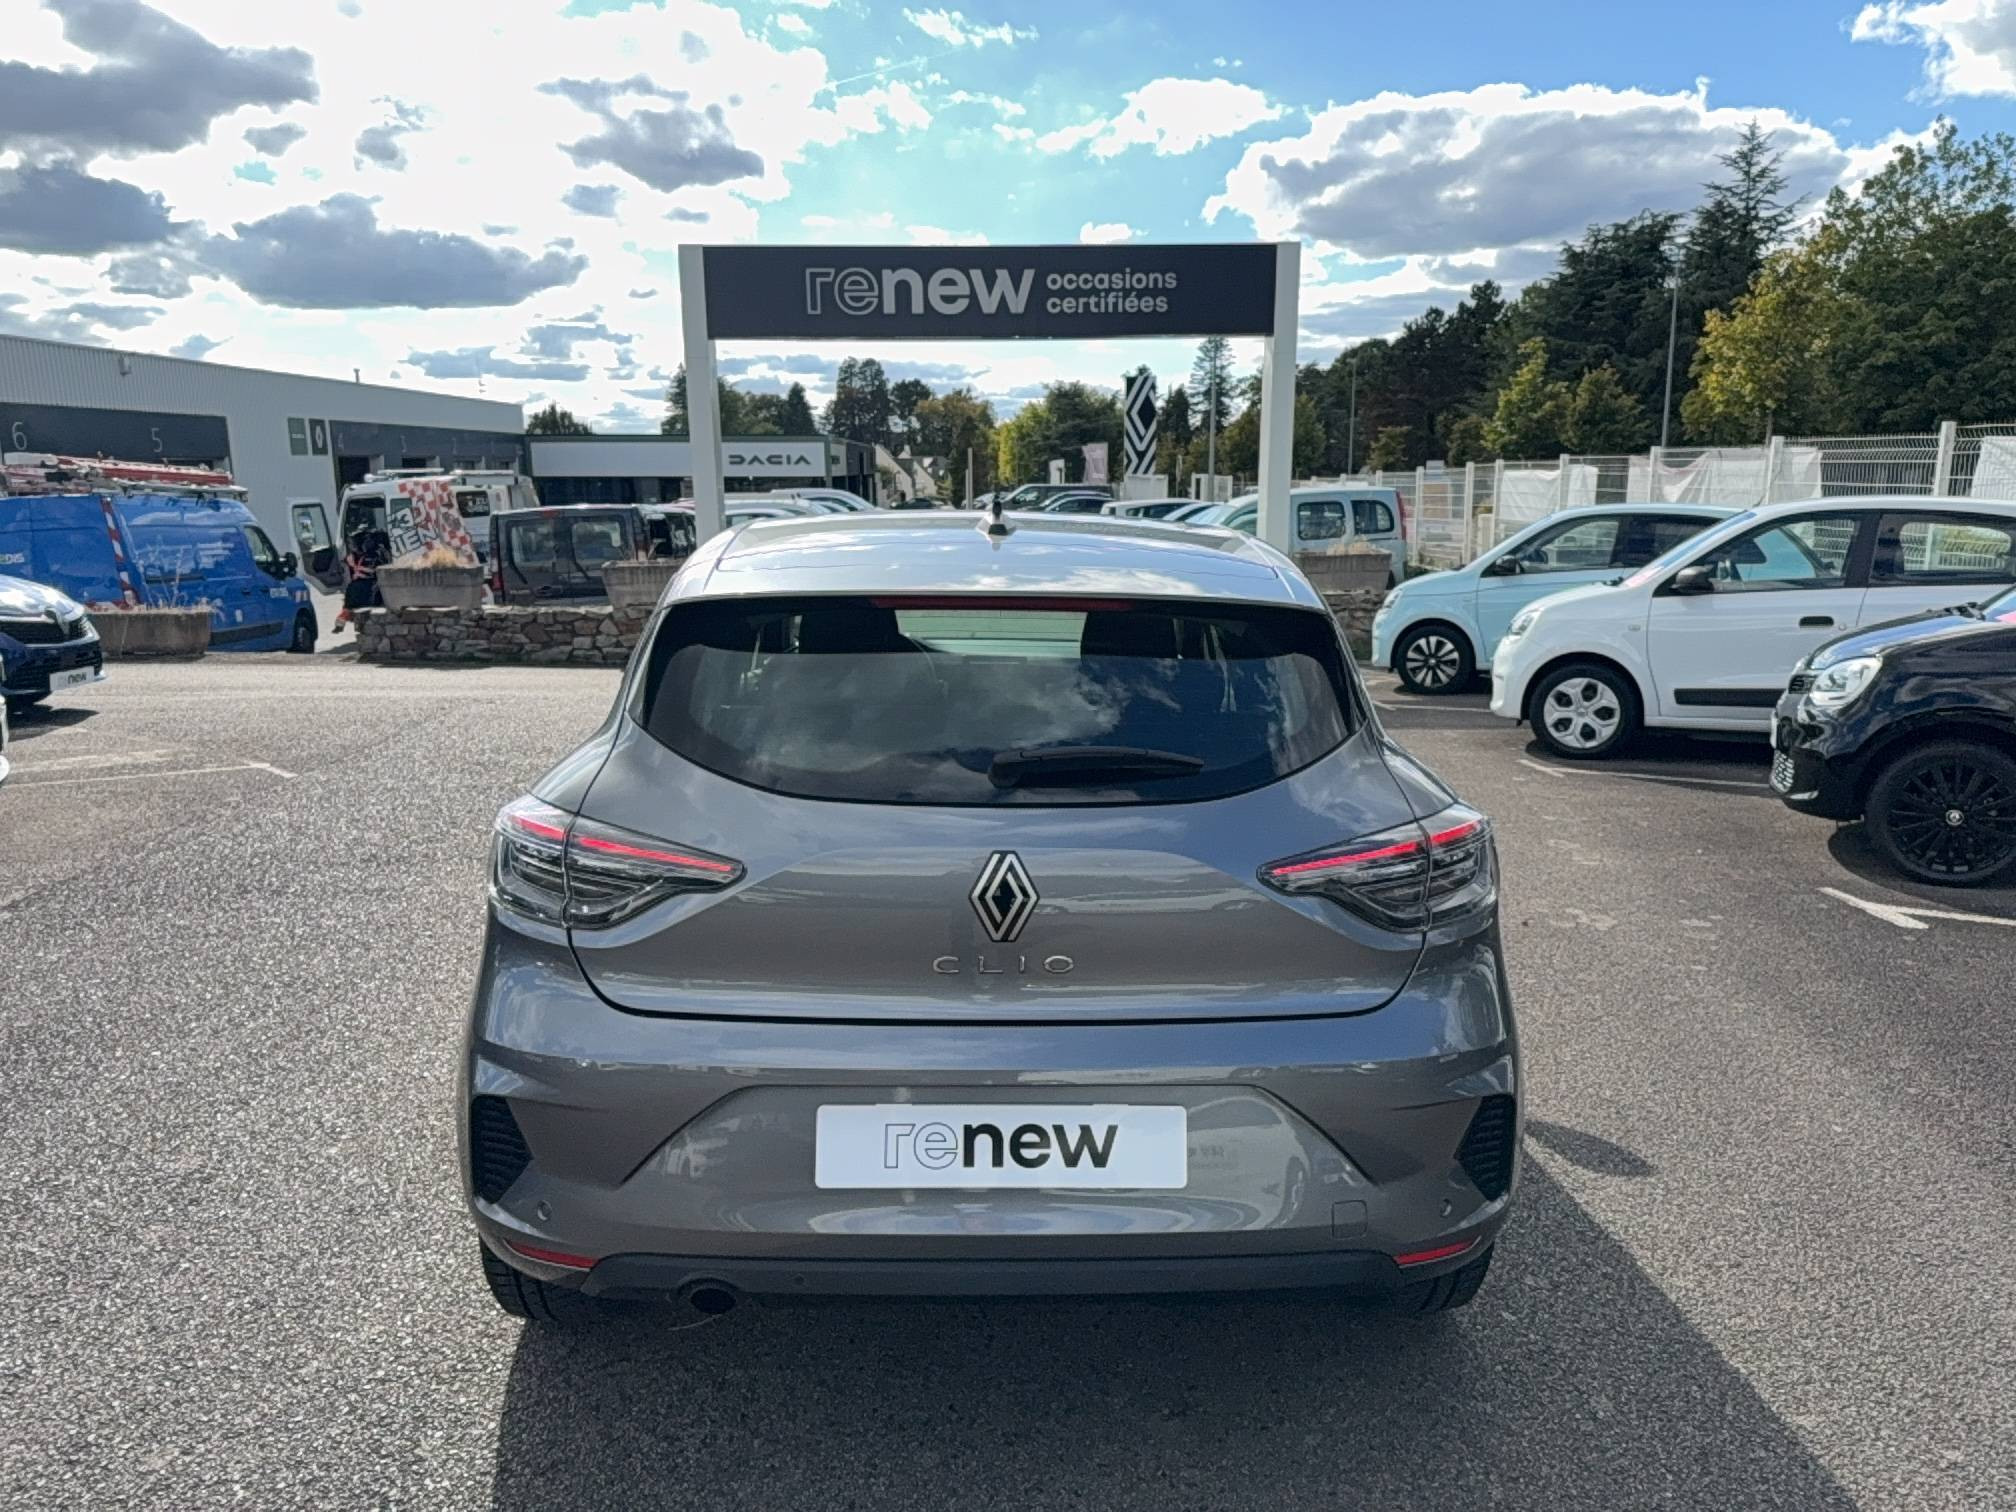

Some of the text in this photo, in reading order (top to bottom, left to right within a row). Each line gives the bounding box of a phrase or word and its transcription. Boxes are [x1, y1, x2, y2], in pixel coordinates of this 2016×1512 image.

[805, 266, 1036, 315] renew
[1046, 267, 1177, 291] occasions
[1046, 291, 1169, 314] certifiées
[11, 421, 28, 451] 6
[151, 427, 163, 453] 5
[728, 454, 811, 465] DACIA
[932, 955, 1075, 974] CLIO
[884, 1122, 1119, 1171] renew
